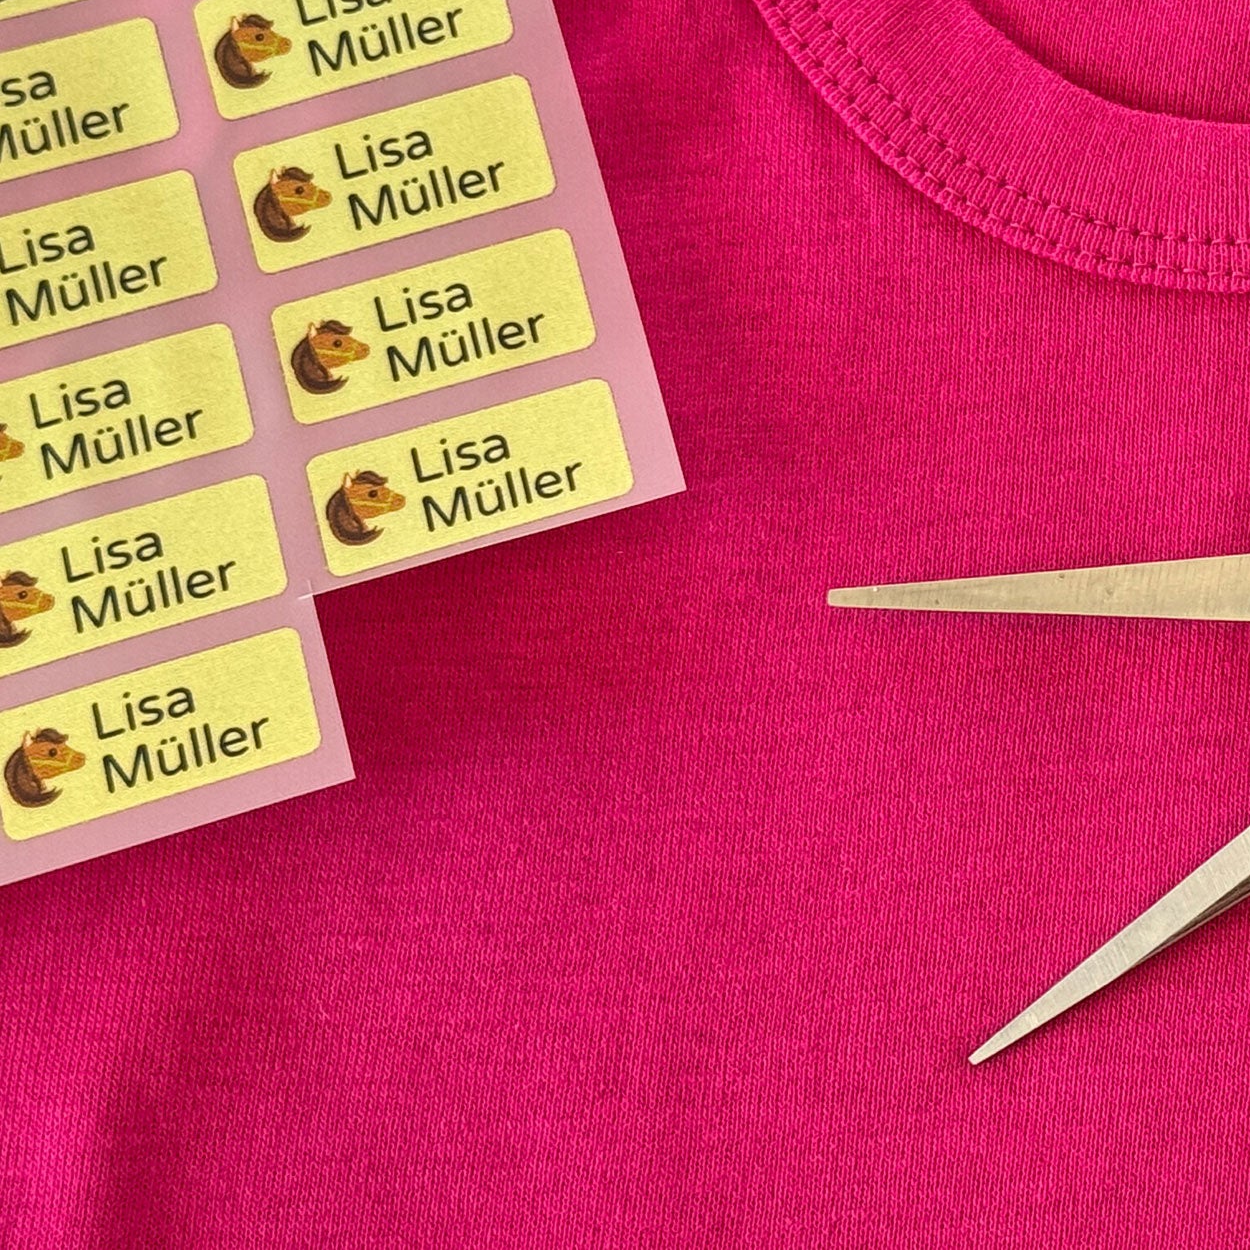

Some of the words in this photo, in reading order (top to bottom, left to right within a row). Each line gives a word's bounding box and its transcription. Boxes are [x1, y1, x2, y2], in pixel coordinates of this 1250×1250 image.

[307, 7, 464, 77] Müller
[334, 129, 433, 180] Lisa
[347, 160, 505, 231] Müller
[0, 224, 95, 275] Lisa
[5, 255, 168, 327] Müller
[373, 282, 473, 333] Lisa
[386, 312, 546, 383] Müller
[29, 379, 132, 430] Lisa
[40, 408, 203, 481] Müller
[410, 433, 511, 484] Lisa
[421, 461, 583, 533] Müller
[60, 531, 165, 584] Lisa
[71, 560, 237, 634] Müller
[91, 685, 196, 741] Lisa
[102, 716, 270, 794] Müller
